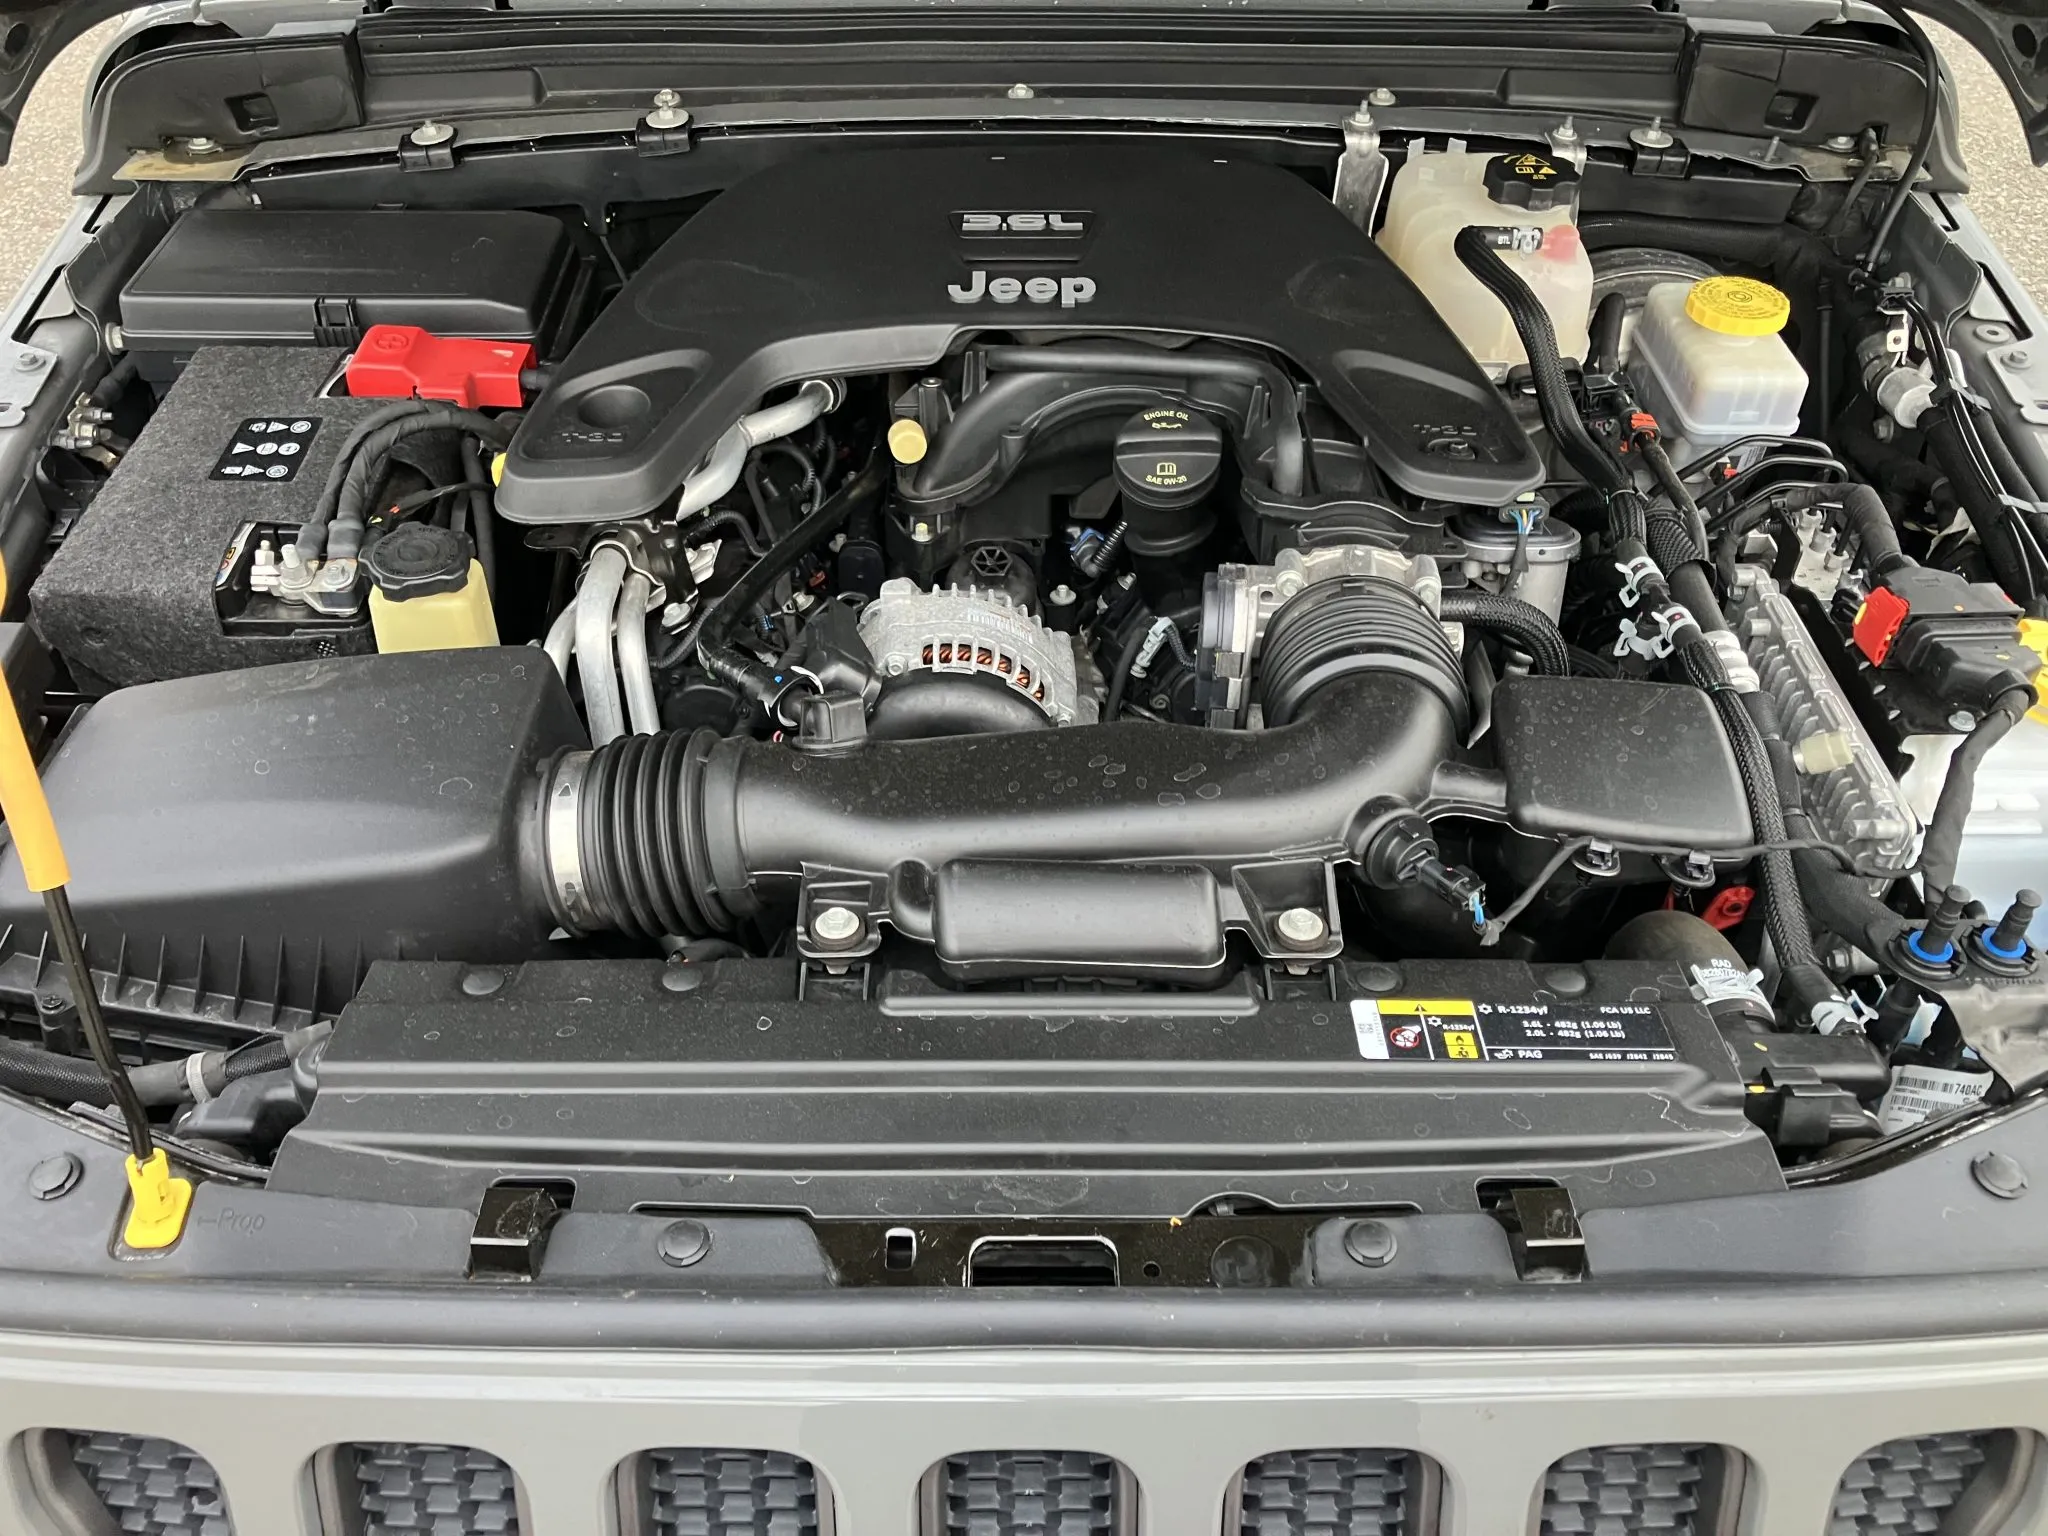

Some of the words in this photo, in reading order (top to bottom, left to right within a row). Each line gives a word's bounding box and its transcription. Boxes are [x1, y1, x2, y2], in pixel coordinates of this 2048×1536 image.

[961, 213, 1084, 231] 3.6L
[947, 270, 1097, 308] Jeep
[1143, 410, 1175, 421] ENGINE
[1176, 411, 1189, 421] OIL
[1145, 474, 1162, 485] SAE
[1163, 475, 1188, 486] 0W-20
[1711, 959, 1732, 968] RAD
[1498, 1004, 1548, 1016] R-1234yf
[1600, 1005, 1620, 1015] FCA
[1621, 1006, 1634, 1015] US
[1635, 1006, 1652, 1015] LLC
[1522, 1020, 1543, 1029] 3.6L
[1607, 1021, 1622, 1030] Lb)
[1526, 1029, 1546, 1038] 2.0L
[1609, 1030, 1626, 1039] Lb)
[1518, 1049, 1543, 1059] PAG
